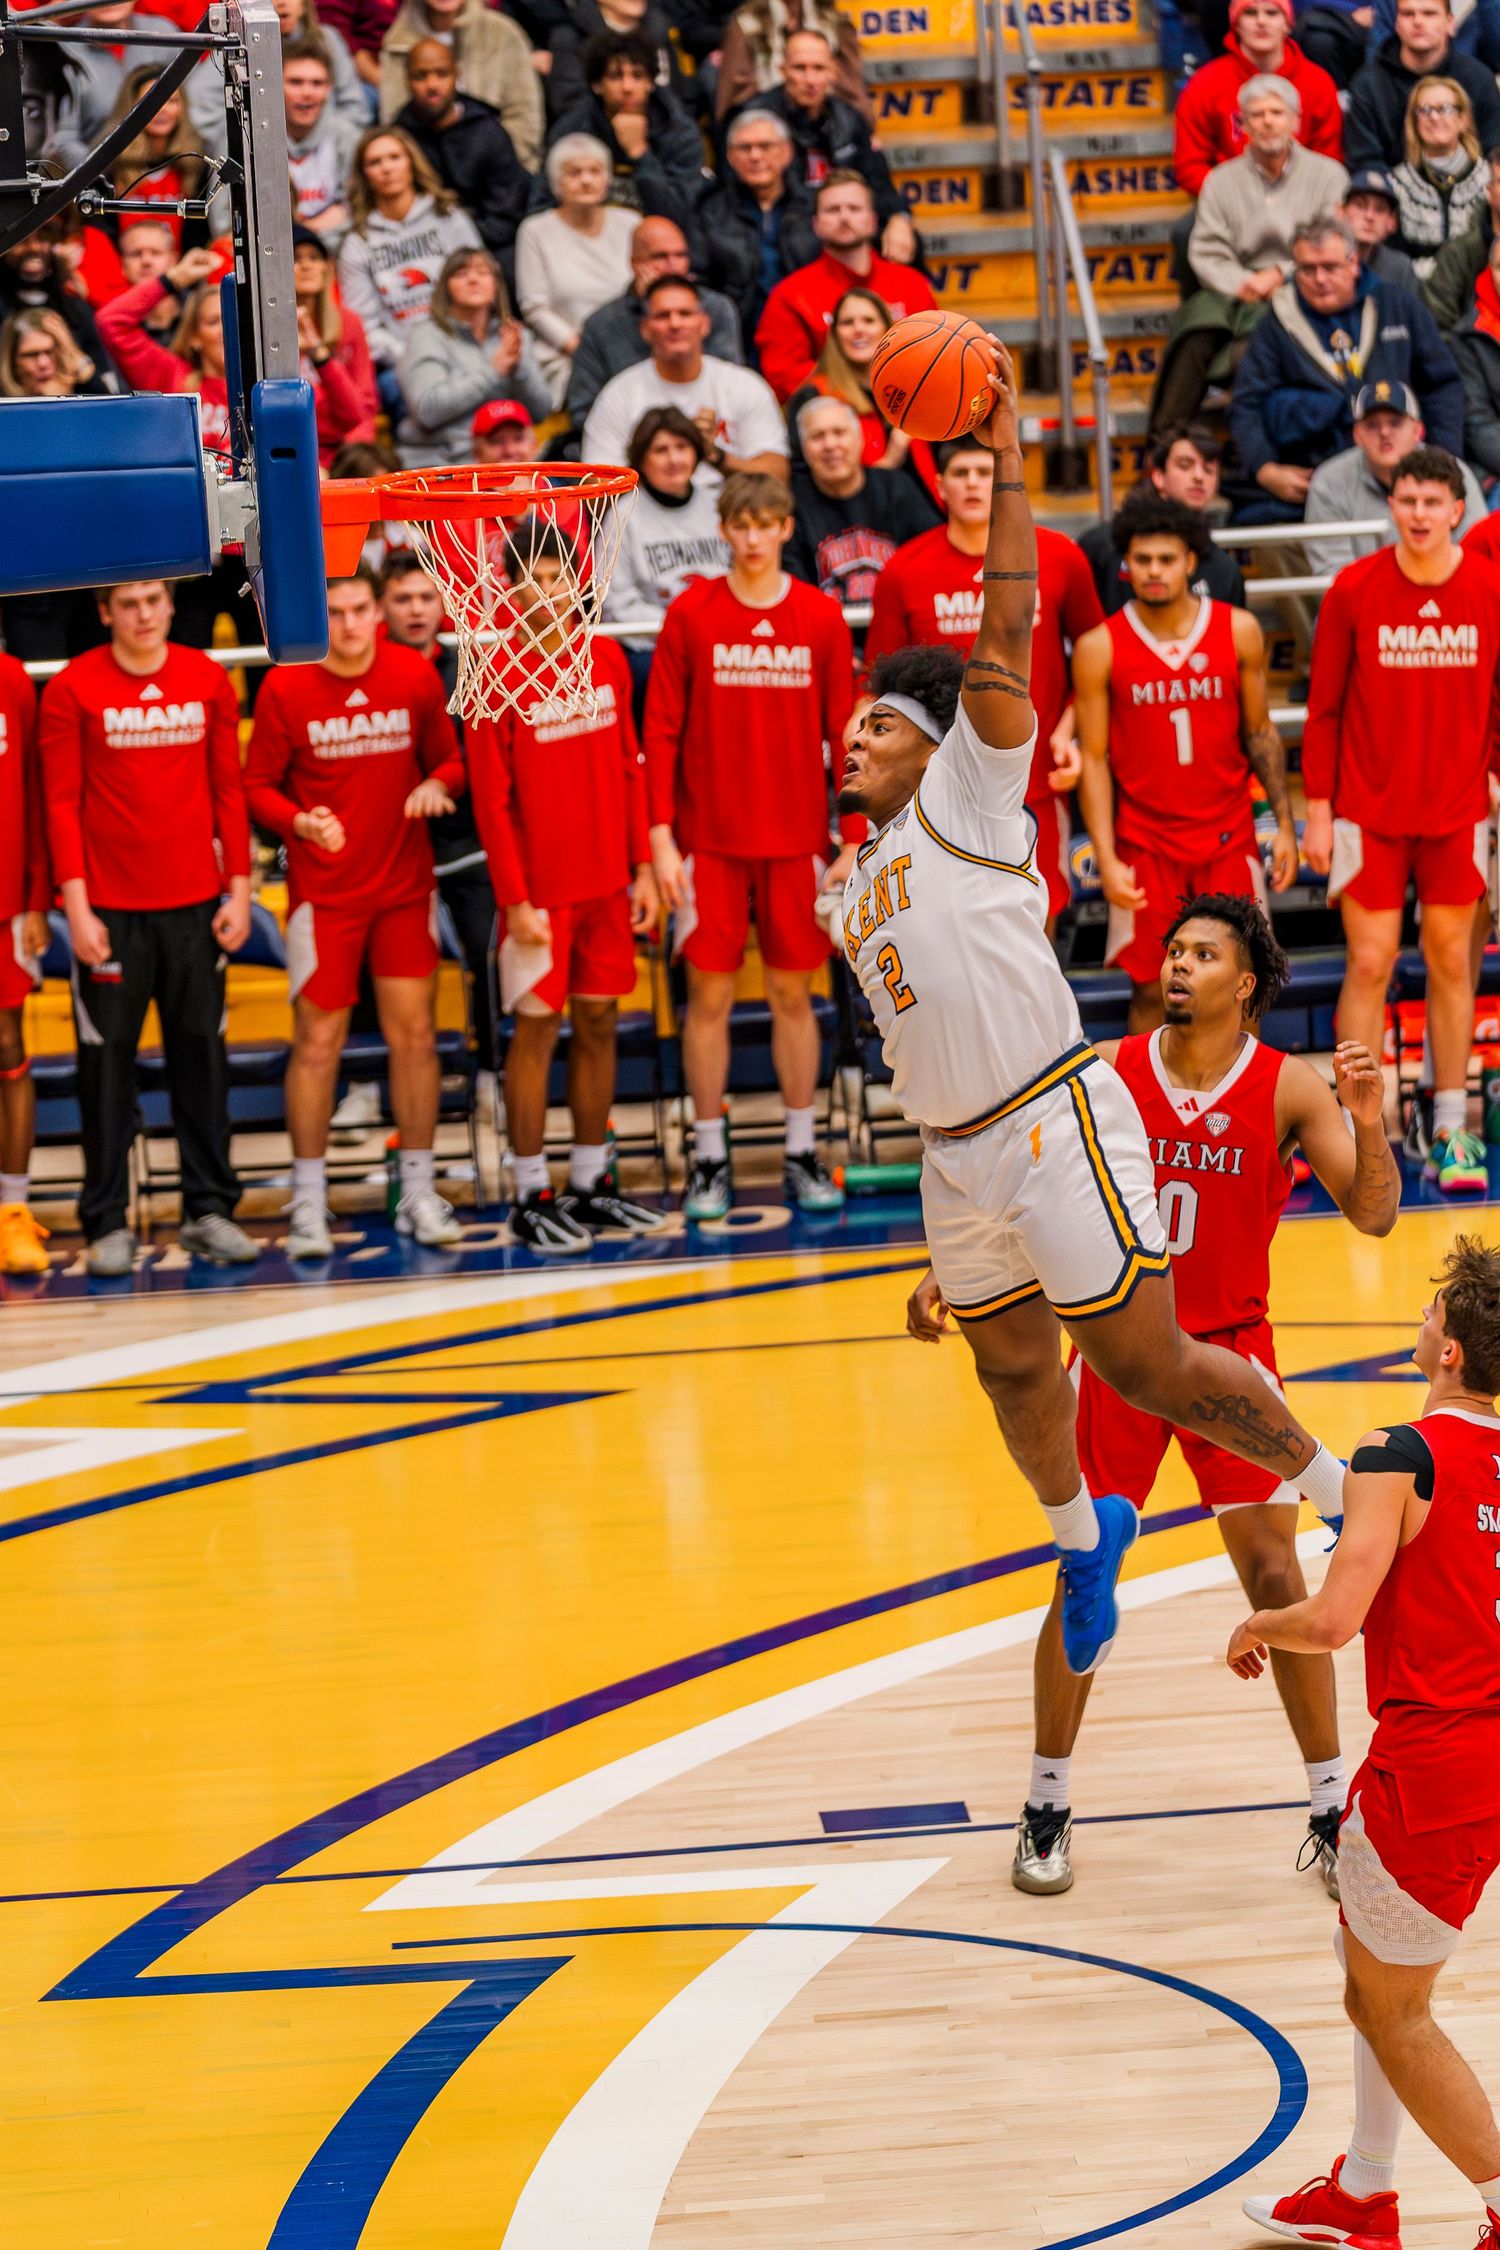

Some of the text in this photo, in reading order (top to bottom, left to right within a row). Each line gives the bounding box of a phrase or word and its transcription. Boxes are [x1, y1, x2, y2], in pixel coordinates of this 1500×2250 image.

[1005, 0, 1132, 28] LASHES
[866, 78, 1152, 118] NT STATE
[1071, 166, 1178, 194] ASHES
[713, 643, 812, 670] MIAMI
[1378, 624, 1478, 651] MIAMI
[1131, 676, 1223, 705] MIAMI
[103, 701, 205, 733] MIAMI
[307, 708, 411, 746] MIAMI
[1169, 707, 1193, 766] 1
[843, 853, 912, 963] KENT
[876, 941, 918, 1016] 2
[1147, 1137, 1246, 1177] IAMI
[1157, 1179, 1199, 1257] 0
